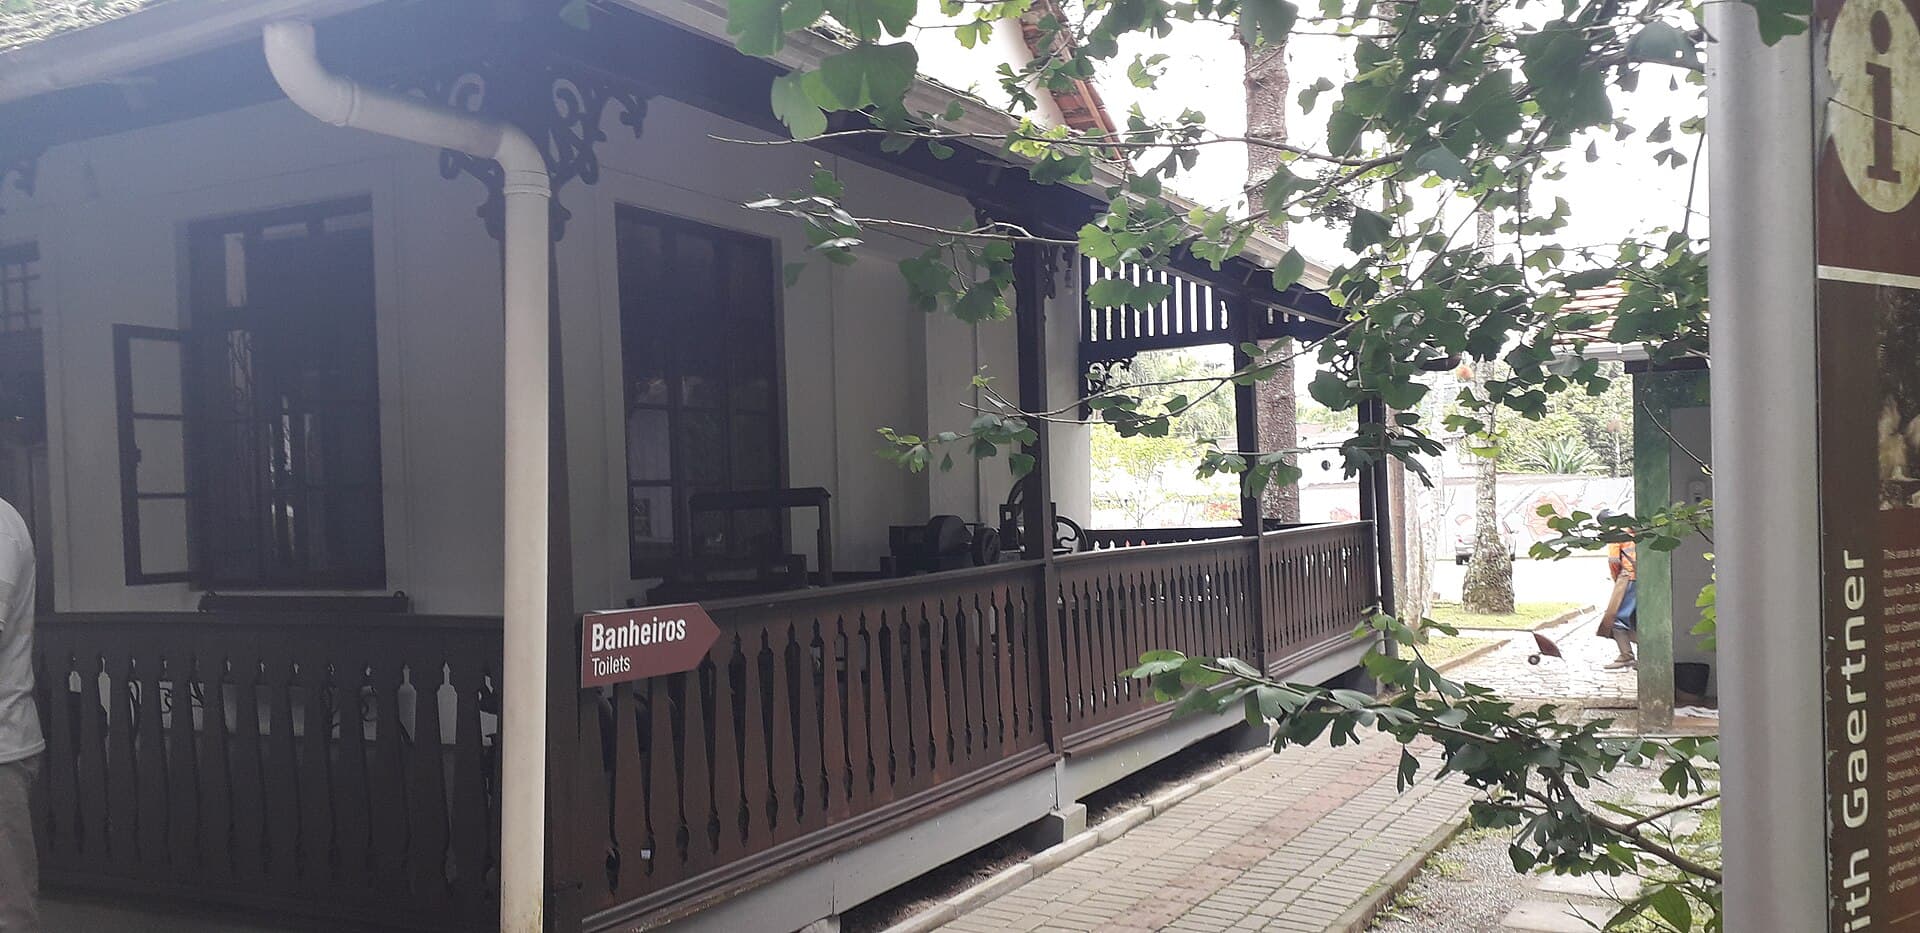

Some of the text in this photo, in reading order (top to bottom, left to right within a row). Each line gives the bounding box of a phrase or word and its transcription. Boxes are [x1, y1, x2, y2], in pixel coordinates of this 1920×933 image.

[591, 616, 687, 652] Banheiros
[591, 655, 631, 676] Toilets
[1840, 549, 1869, 829] Gaertner
